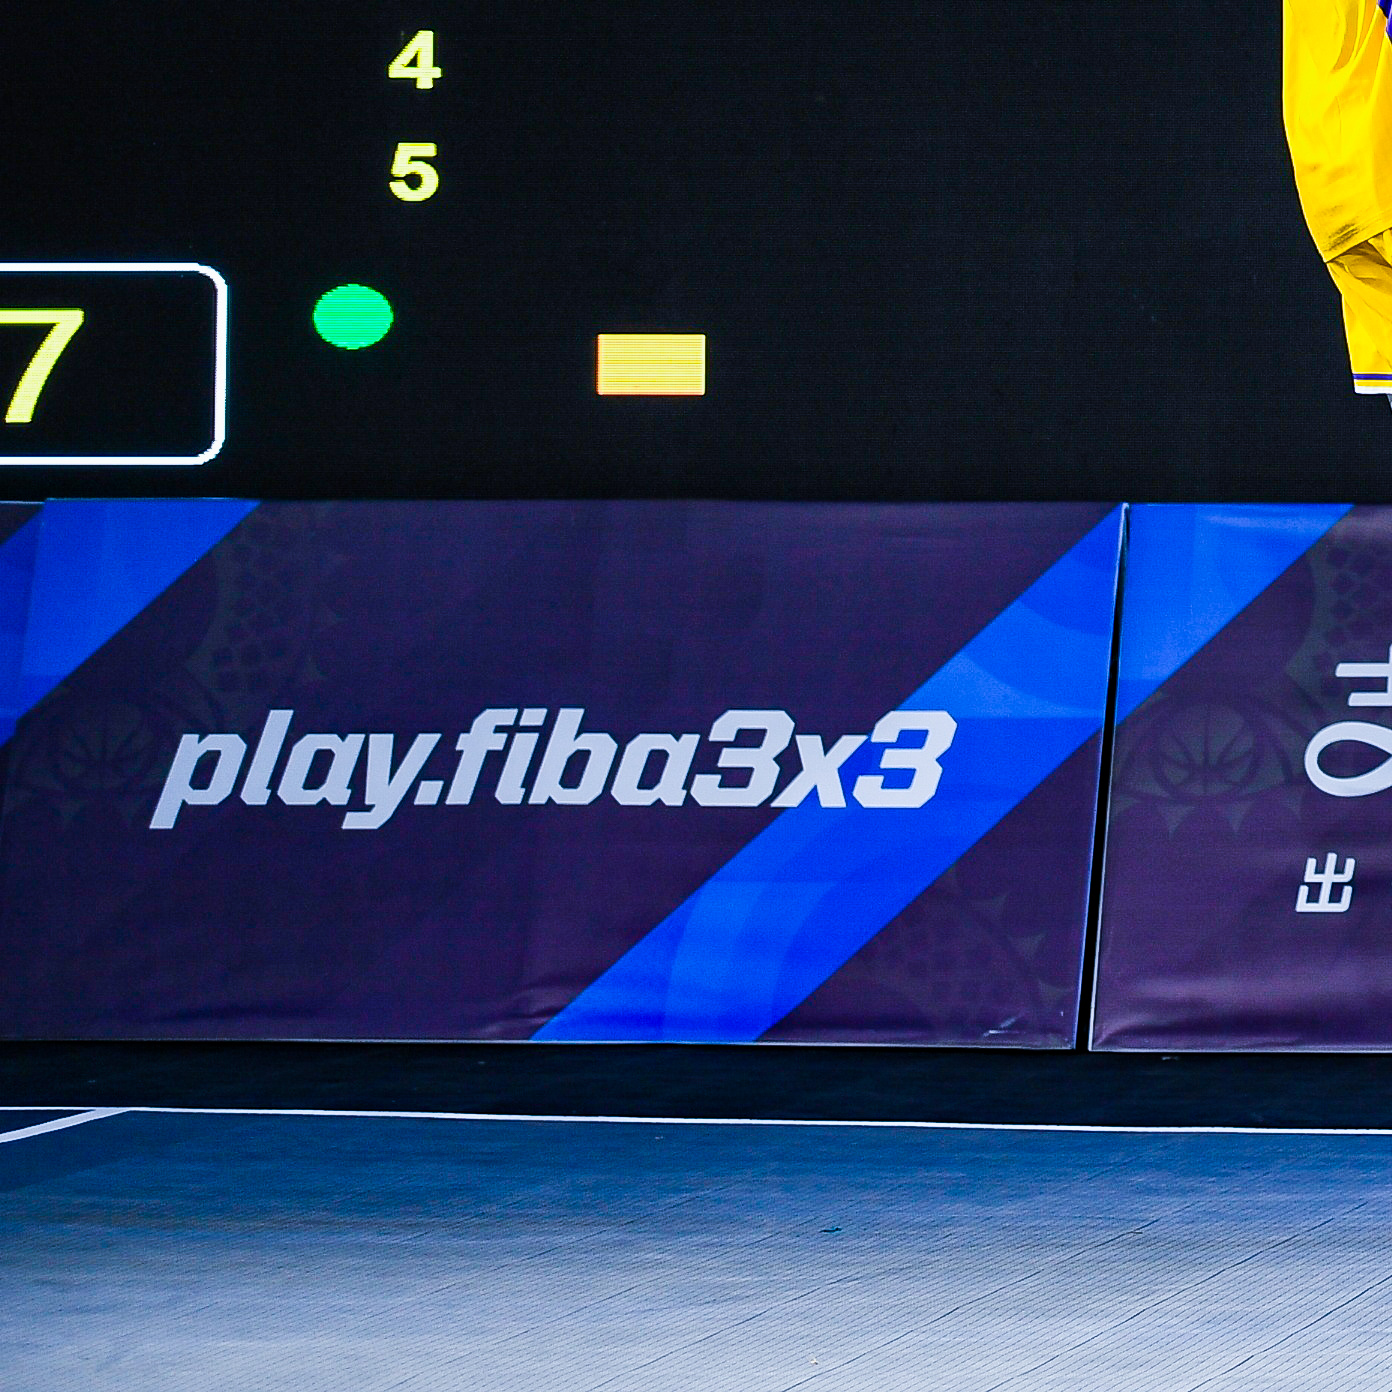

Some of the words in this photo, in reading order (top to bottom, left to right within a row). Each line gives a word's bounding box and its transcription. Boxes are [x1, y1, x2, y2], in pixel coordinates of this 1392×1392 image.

[388, 30, 442, 90] 4
[389, 143, 439, 202] 5
[0, 308, 84, 424] 7
[149, 708, 958, 830] play.fiba3x3
